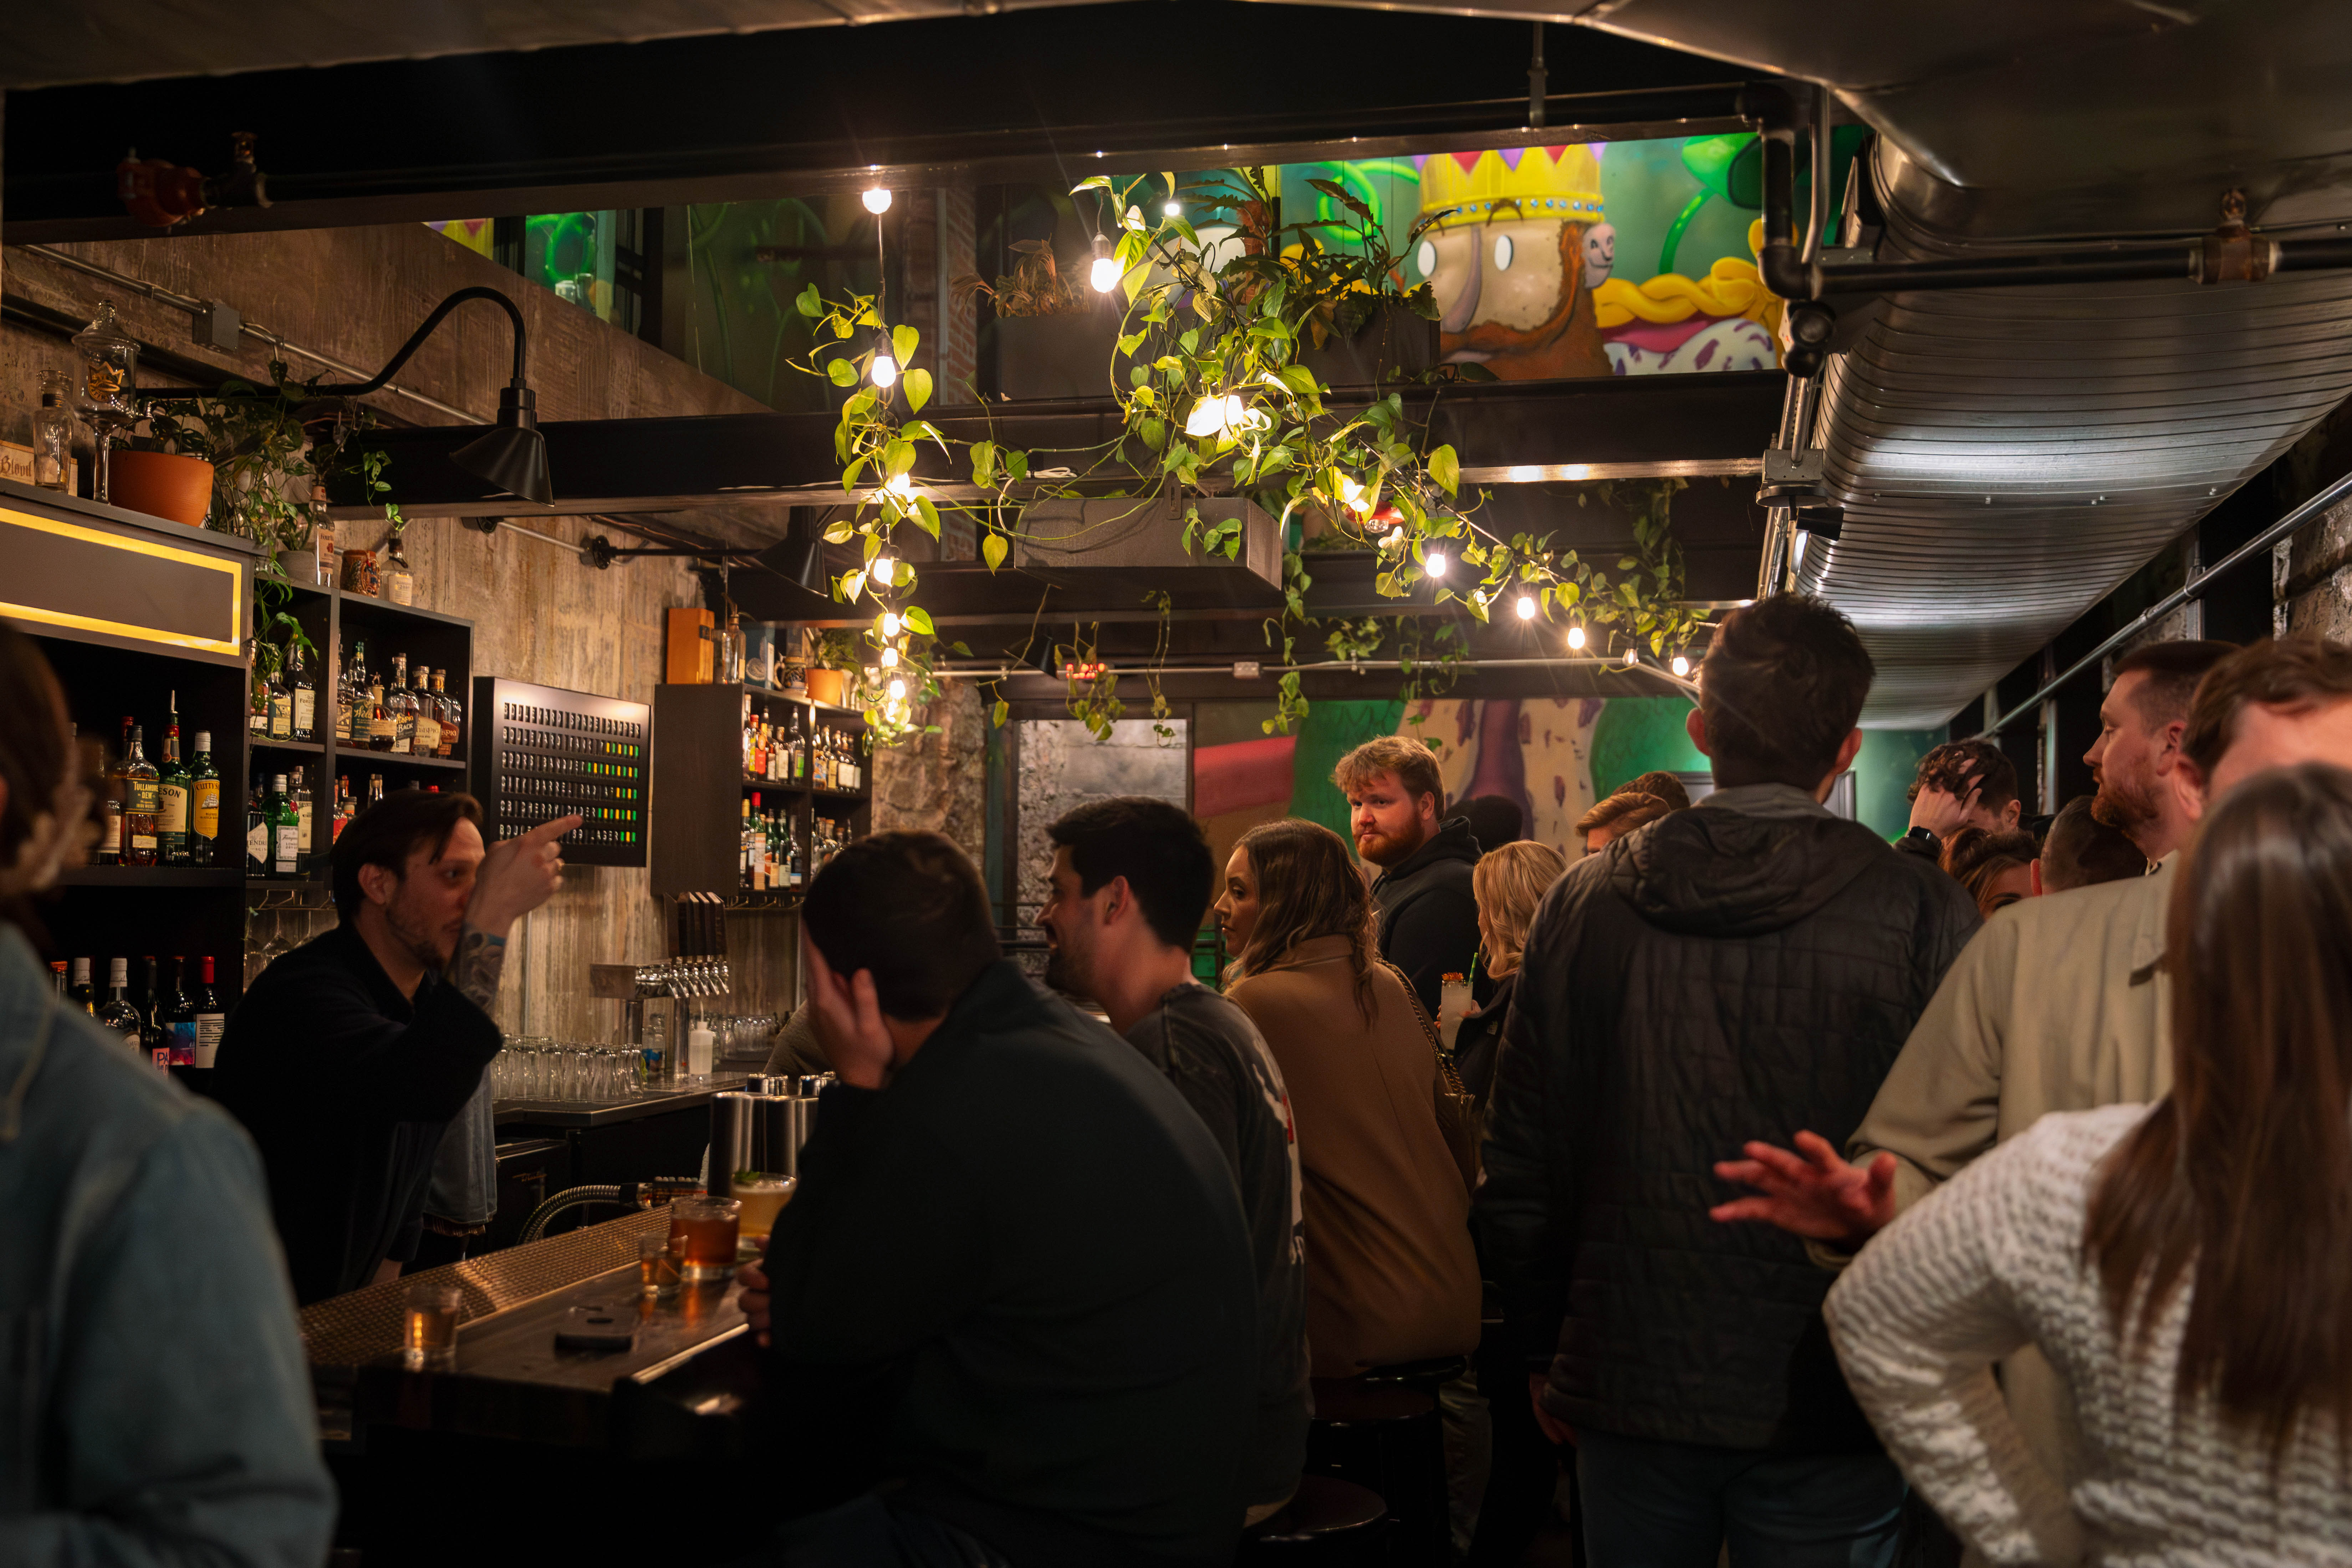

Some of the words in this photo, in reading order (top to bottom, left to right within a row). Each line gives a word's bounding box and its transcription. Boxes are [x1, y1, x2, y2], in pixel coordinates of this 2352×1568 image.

[504, 704, 561, 725] BOULEVARD
[503, 728, 561, 746] BOULEVARD
[502, 752, 534, 767] COORS
[543, 757, 585, 771] BANQUET
[502, 776, 527, 787] CITY
[536, 779, 571, 793] BARREL
[521, 801, 559, 815] CHERRY
[567, 805, 596, 818] CIDER
